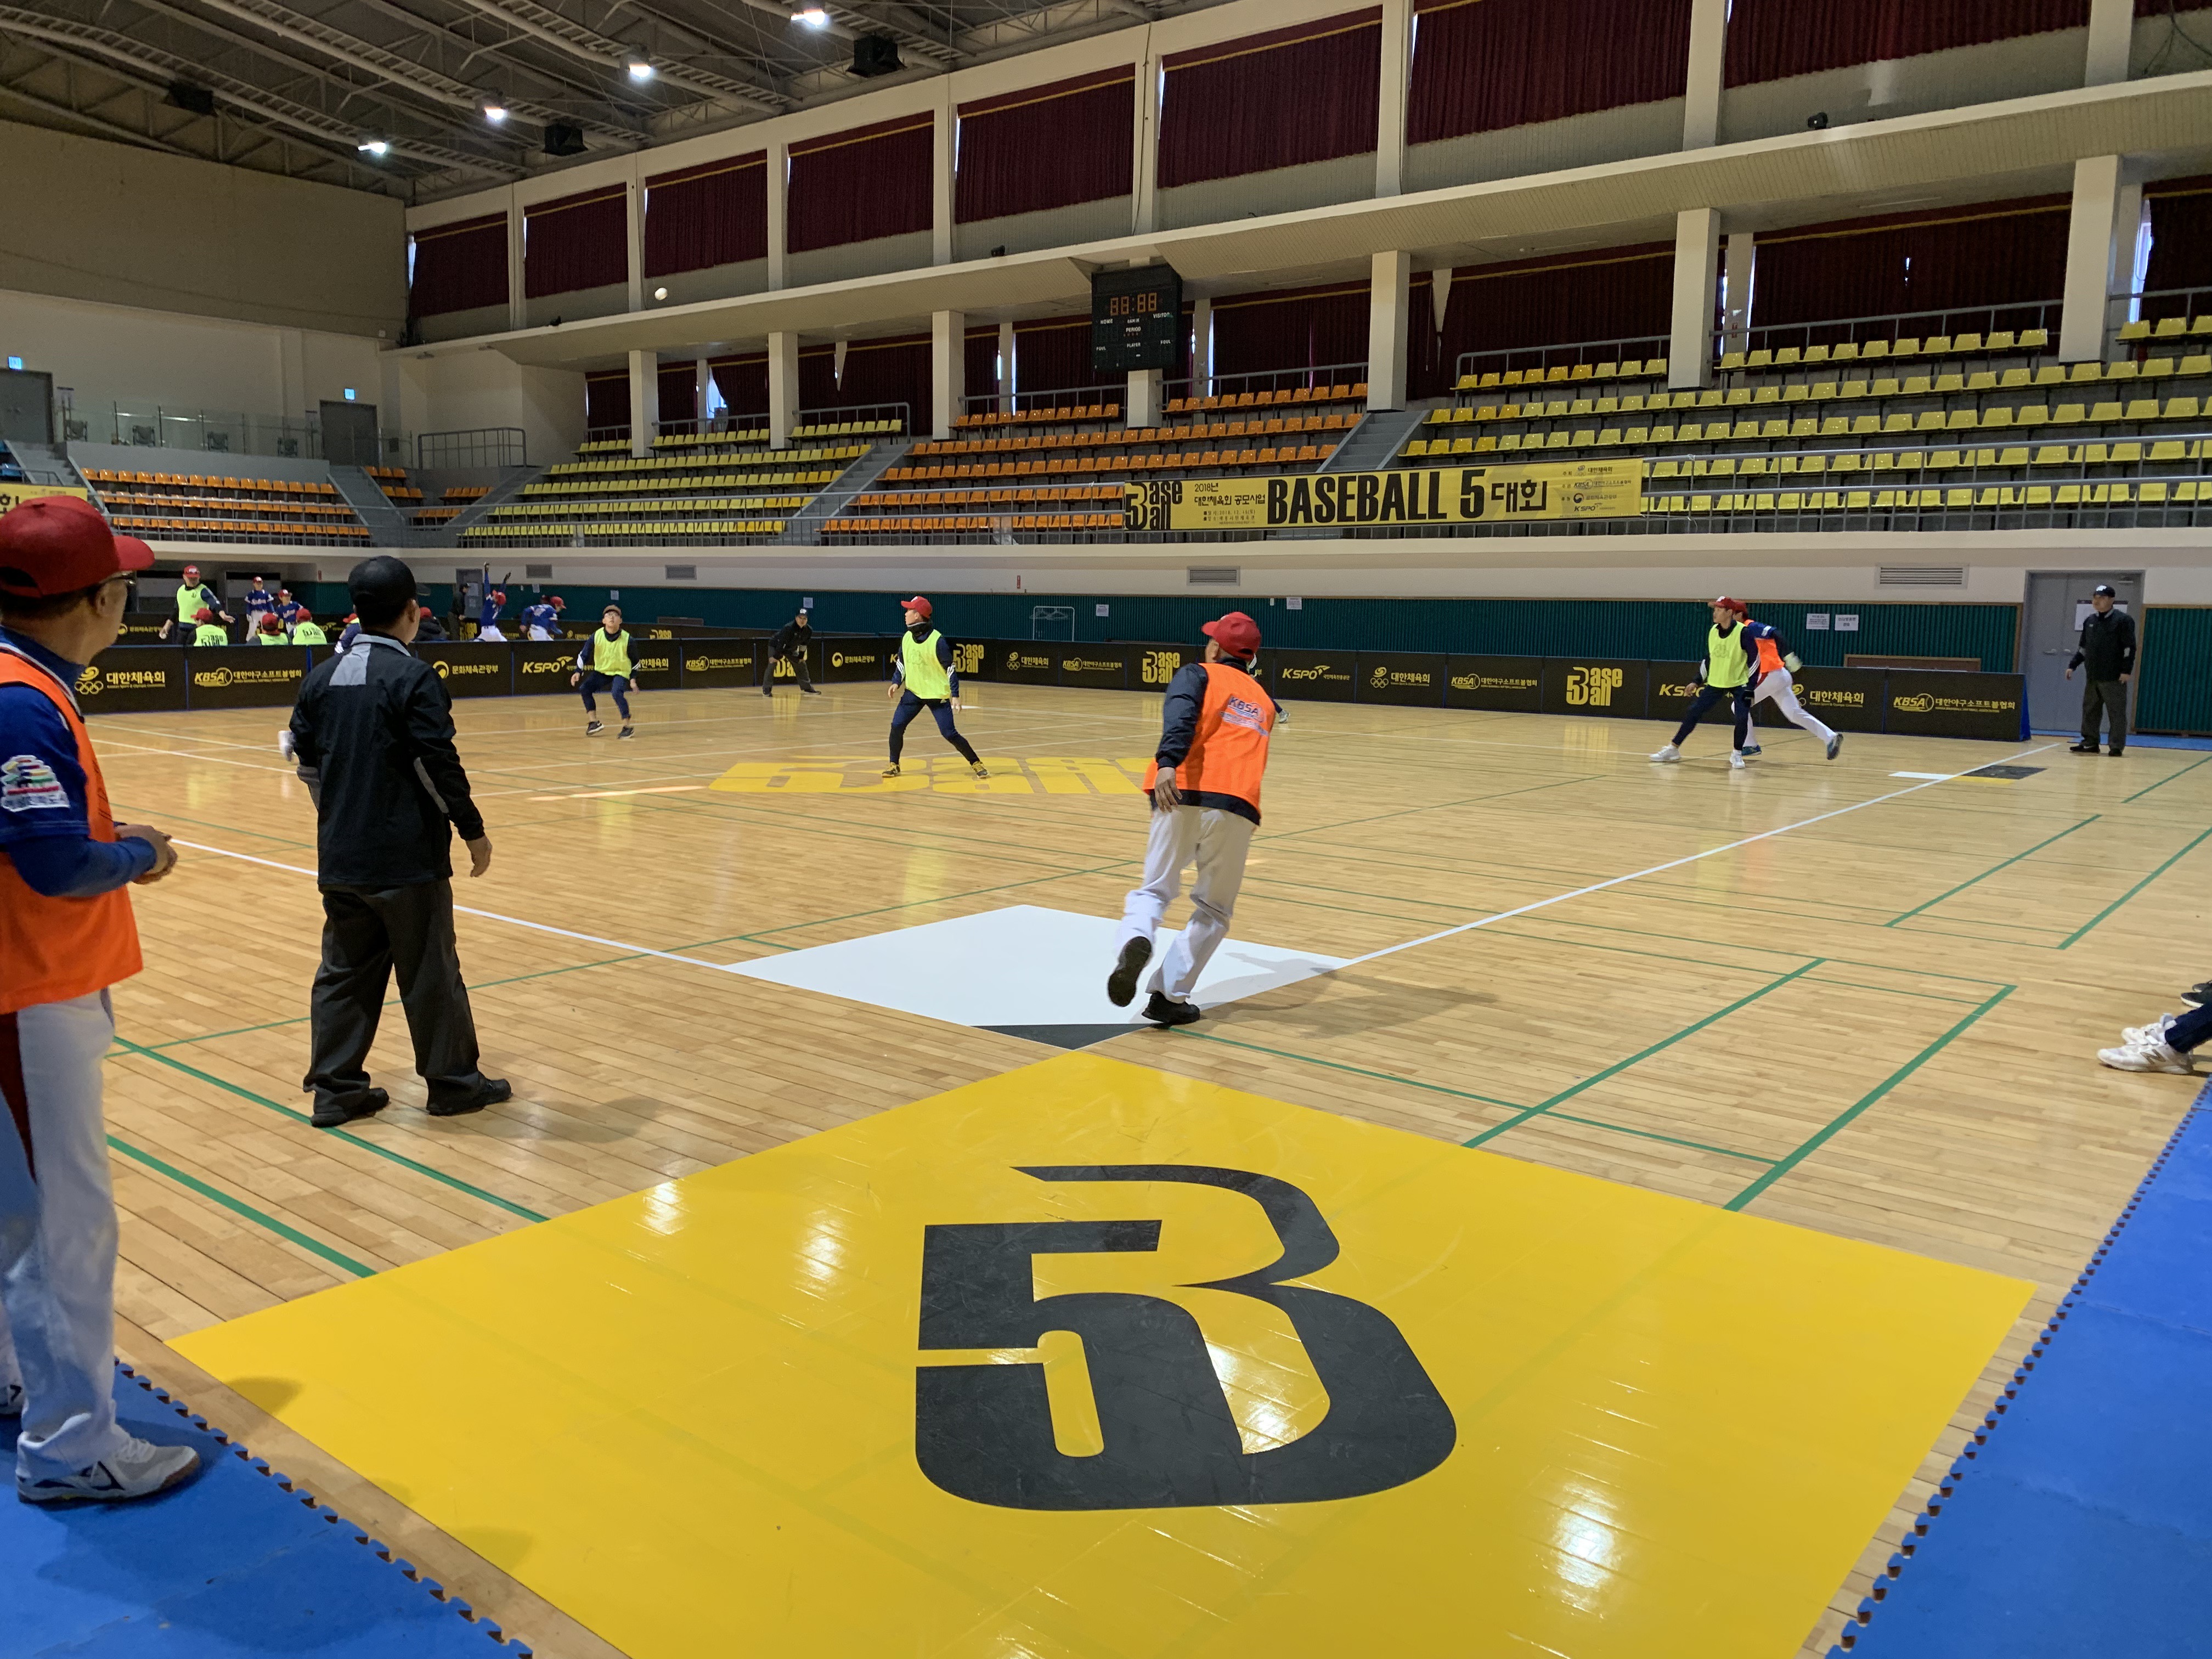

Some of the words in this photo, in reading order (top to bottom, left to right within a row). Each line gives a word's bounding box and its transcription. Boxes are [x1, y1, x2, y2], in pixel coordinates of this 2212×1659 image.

[1194, 483, 1218, 493] 2018년
[1194, 495, 1232, 506] 대한체육회
[1234, 494, 1265, 505] 공모사업
[1268, 471, 1447, 524] BASEBALL
[639, 658, 669, 669] 한체육회
[686, 660, 706, 668] KBSA
[1021, 657, 1049, 666] 대한체육회
[452, 664, 499, 674] 문화체육관광부
[522, 662, 561, 673] KSPO
[106, 671, 165, 685] 대한체육회
[194, 672, 225, 682] KBSA
[233, 669, 302, 680] 대한야구소프트볼협회
[1282, 668, 1318, 680] KSPO
[1391, 672, 1430, 683] 대한체육회
[1451, 676, 1475, 685] KBSA
[1481, 678, 1537, 687] 대한야구소프트볼협회
[1810, 690, 1864, 704] 대한체육회
[1894, 696, 1926, 707] KBSA
[1936, 698, 2016, 709] 대한야구소프트볼협회
[1228, 697, 1259, 716] KBSA
